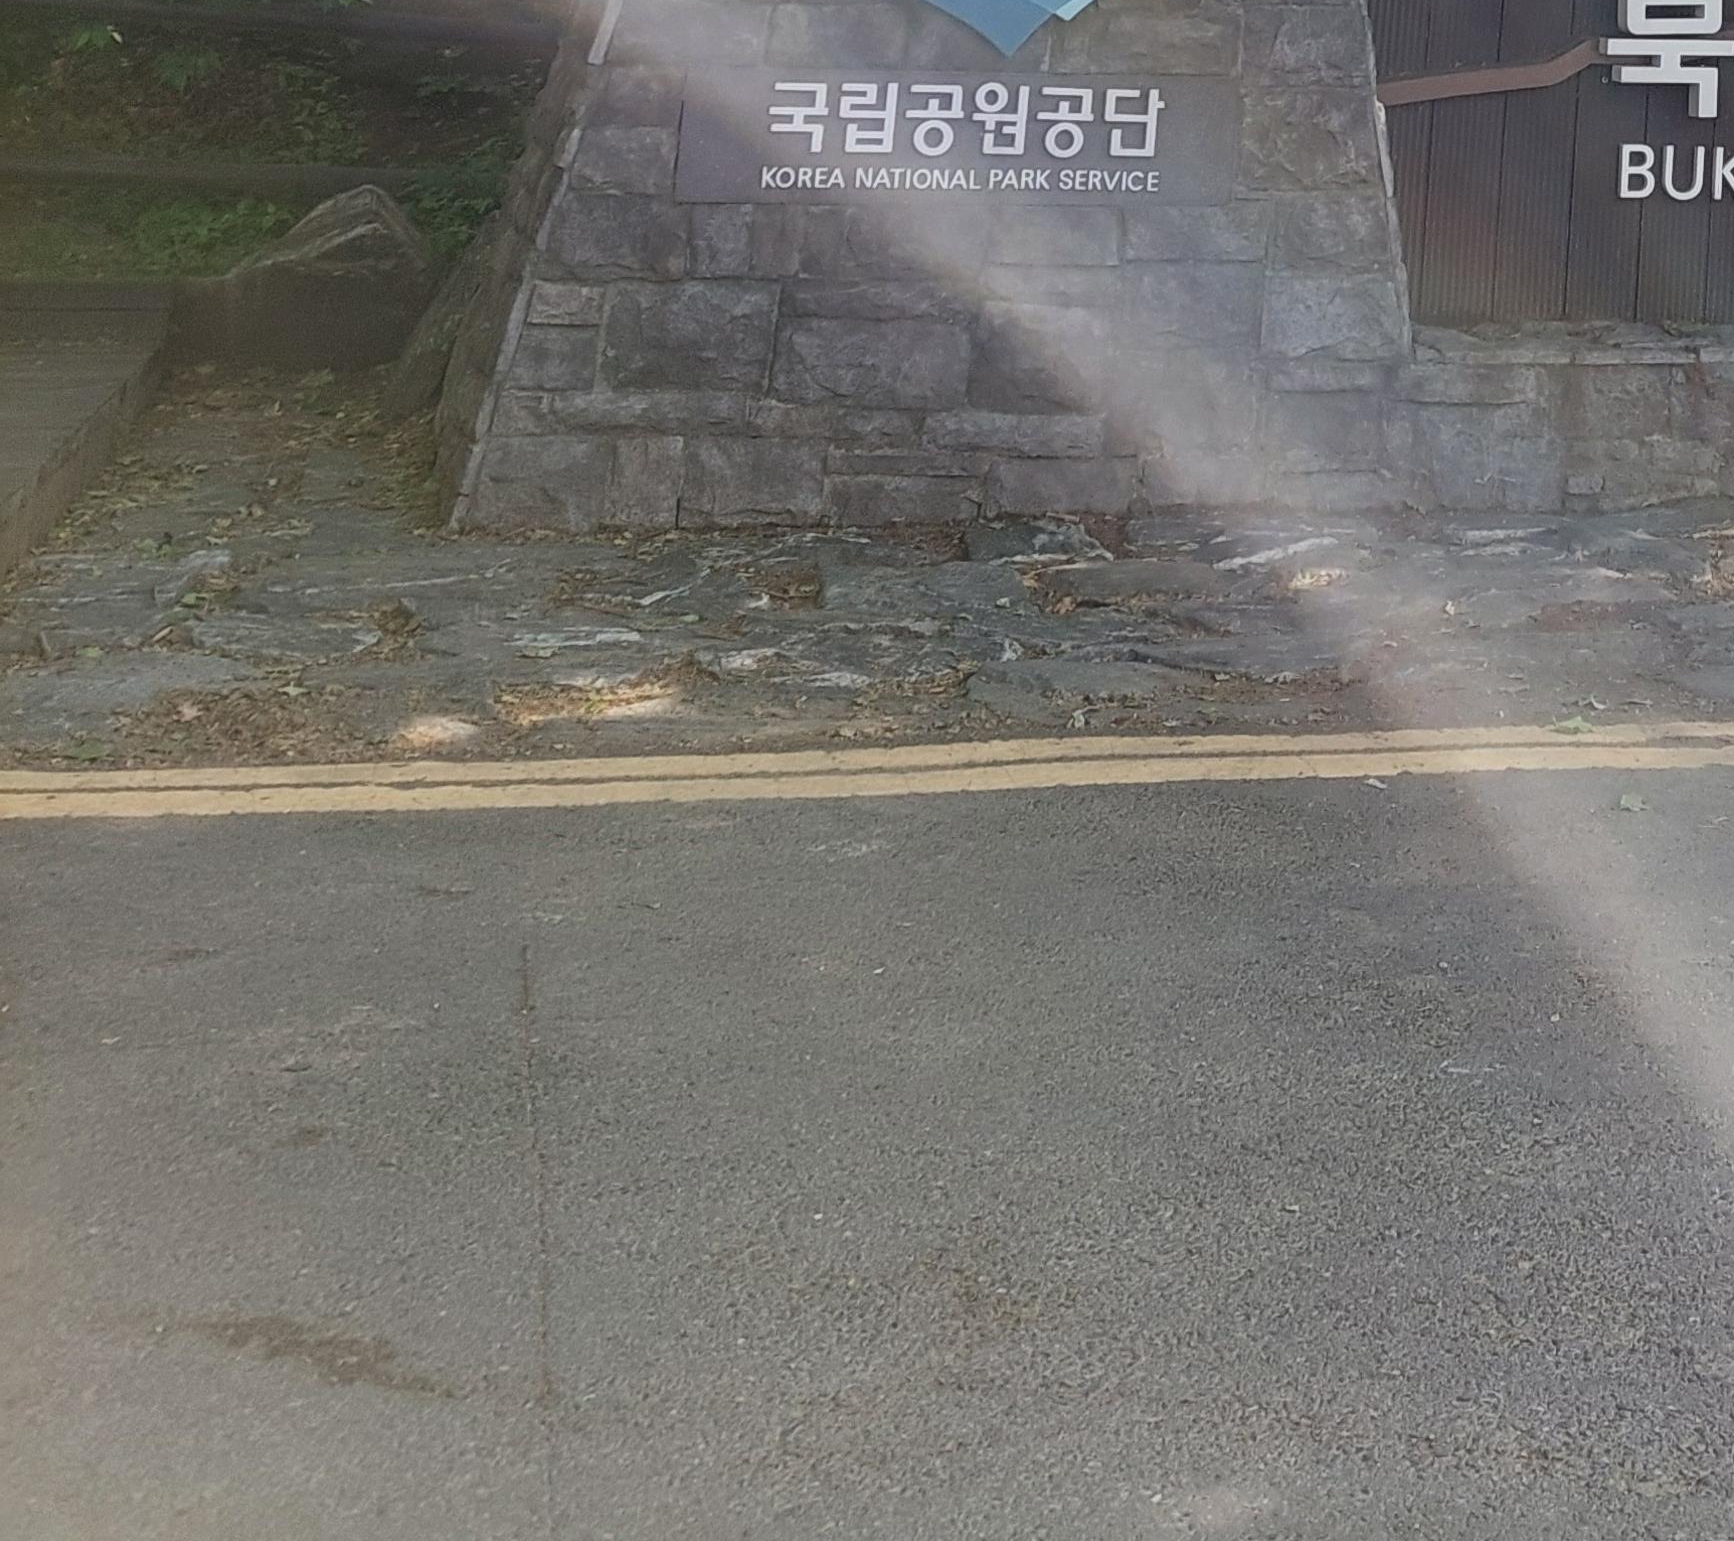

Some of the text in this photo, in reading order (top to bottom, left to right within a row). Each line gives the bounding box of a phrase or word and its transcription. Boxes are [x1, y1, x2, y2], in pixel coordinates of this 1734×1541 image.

[768, 81, 1166, 159] 국립공원공단
[760, 166, 1160, 192] KOREA NATIONAL PARK SERVICE
